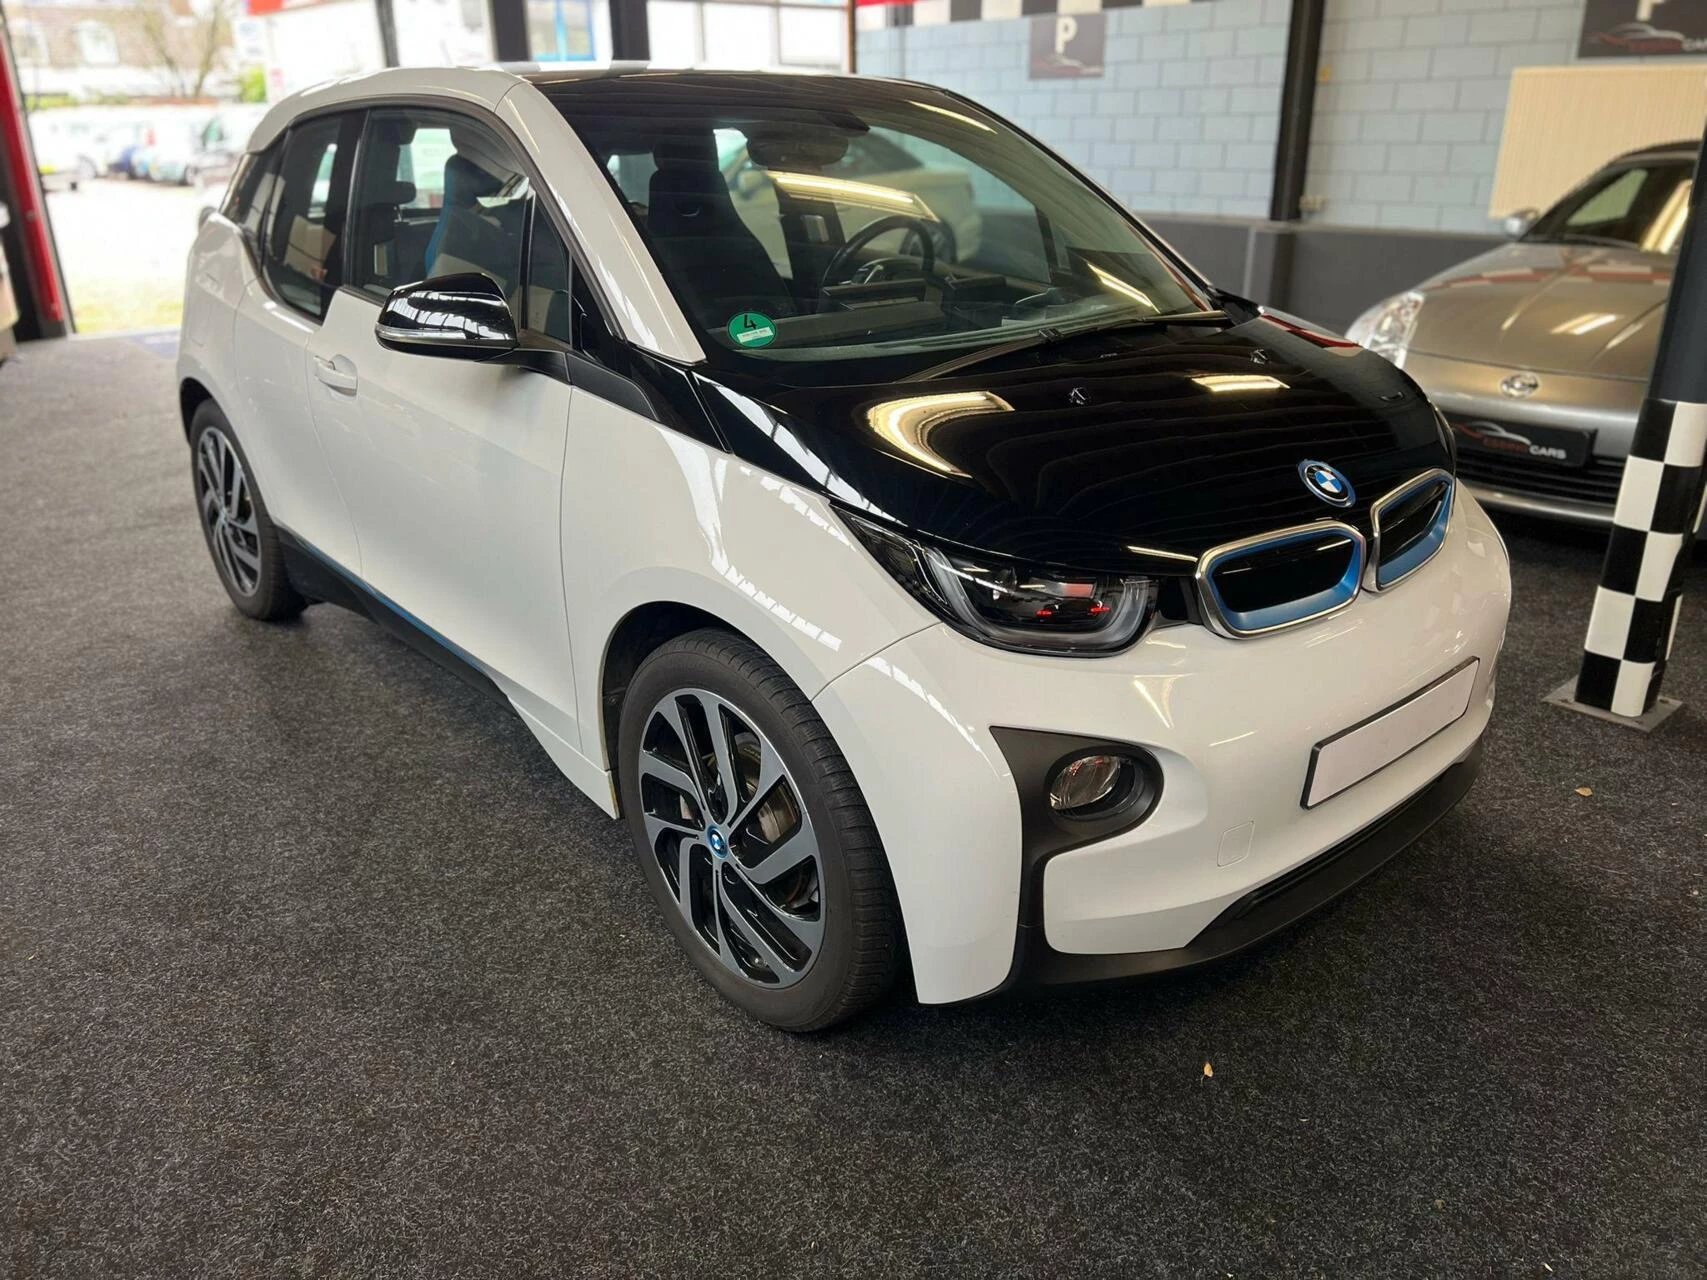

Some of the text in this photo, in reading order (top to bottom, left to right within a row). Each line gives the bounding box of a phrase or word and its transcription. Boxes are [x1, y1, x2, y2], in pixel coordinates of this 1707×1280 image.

[1056, 15, 1077, 53] P
[744, 314, 757, 329] 4
[1529, 444, 1566, 459] CARS
